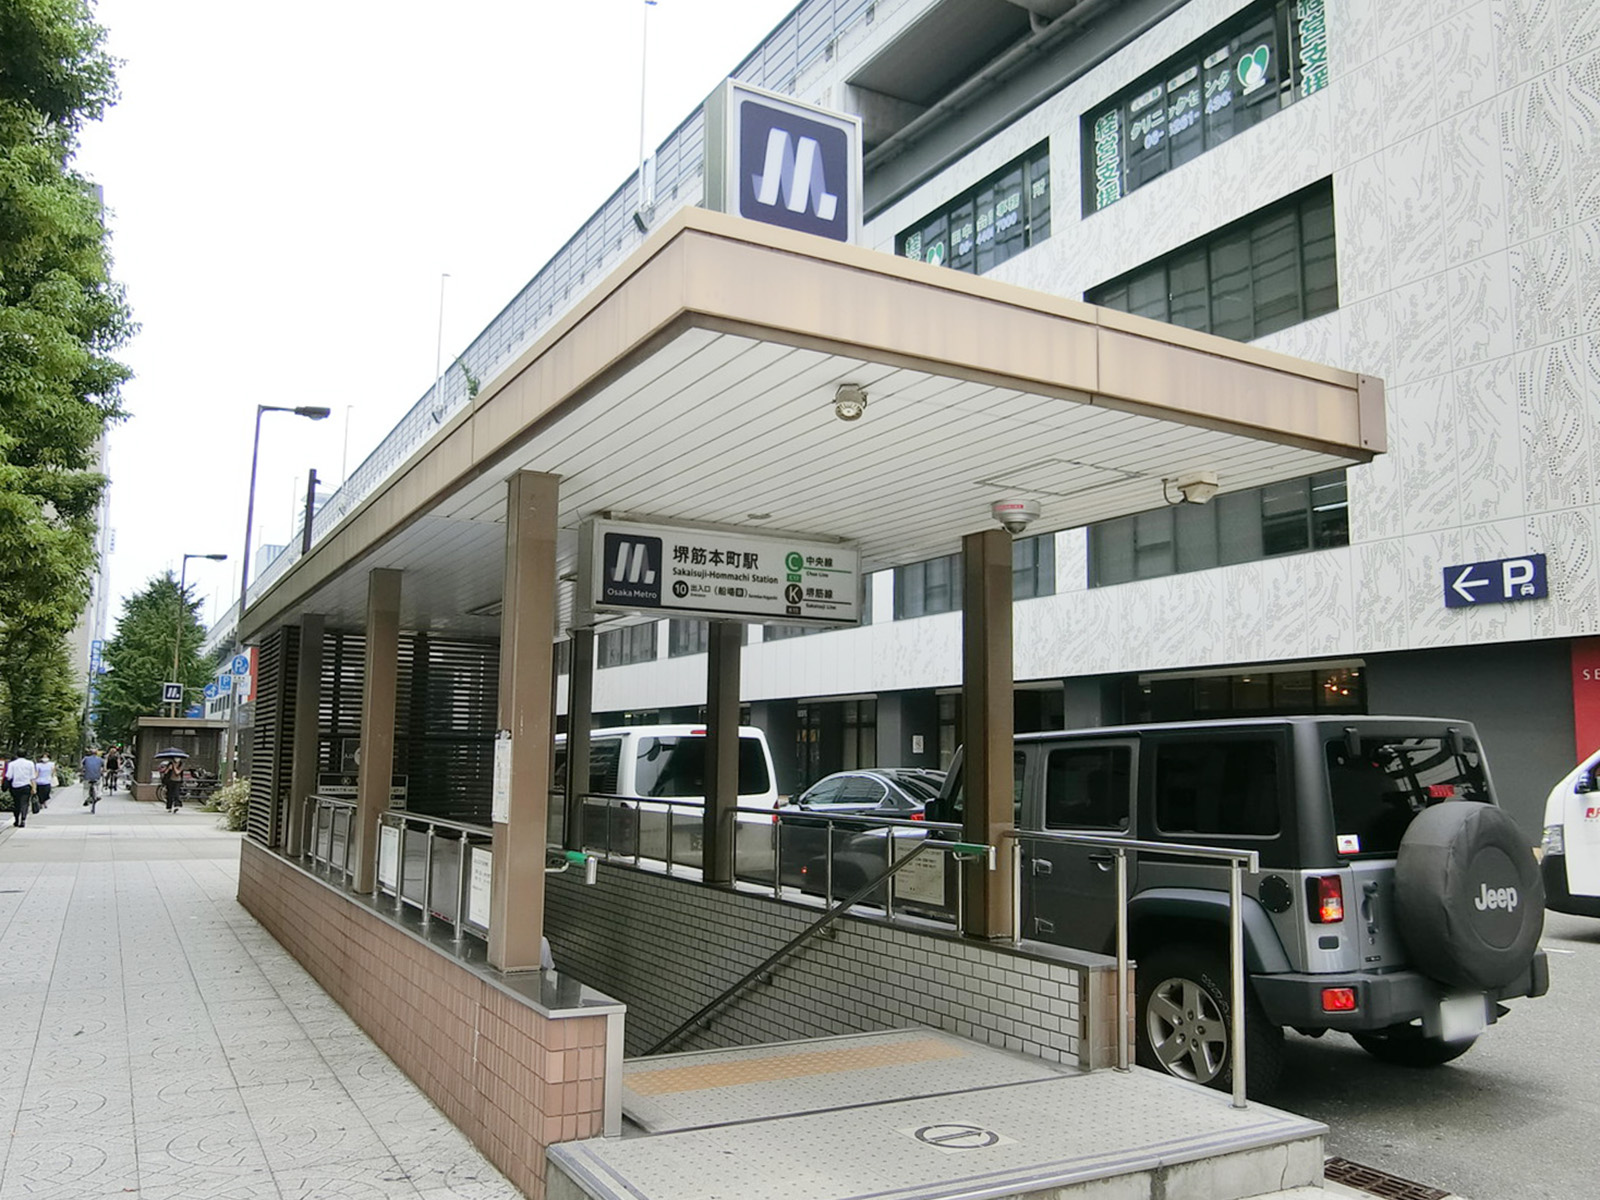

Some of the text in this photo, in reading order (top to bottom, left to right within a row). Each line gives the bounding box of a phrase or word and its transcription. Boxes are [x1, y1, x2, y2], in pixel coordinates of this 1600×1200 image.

[673, 545, 758, 570] 堺筋本町駅
[806, 556, 833, 567] 中央線
[752, 574, 778, 584] Station
[1502, 559, 1534, 598] P
[607, 588, 658, 599] Osaka Metro
[1475, 883, 1518, 912] Jeep
